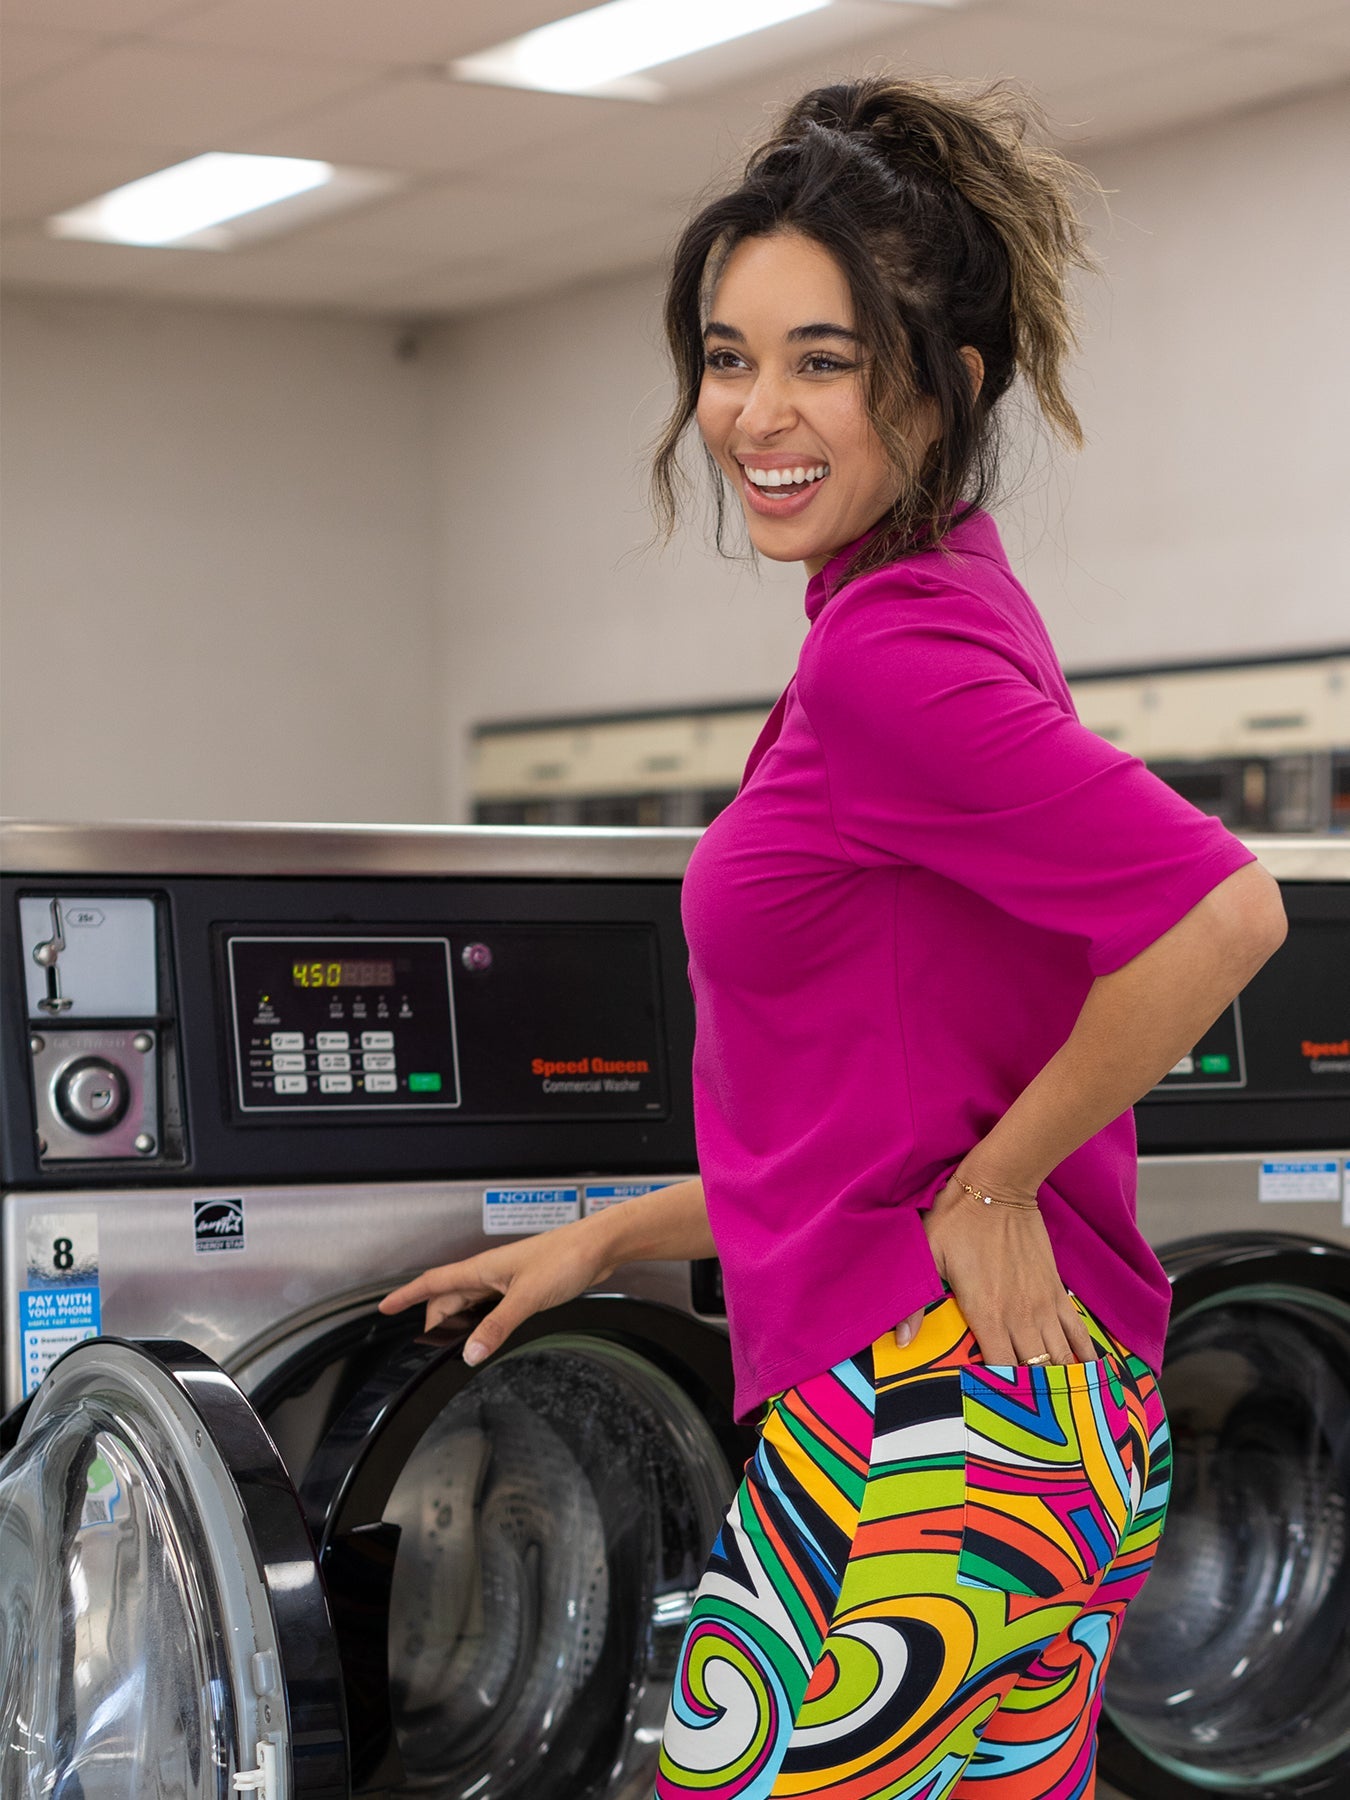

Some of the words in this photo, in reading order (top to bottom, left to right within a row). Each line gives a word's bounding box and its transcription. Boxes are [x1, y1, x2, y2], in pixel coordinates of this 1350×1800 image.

[531, 1058, 589, 1078] Speed
[591, 1057, 649, 1073] Queen
[542, 1079, 602, 1093] Commercial
[603, 1079, 641, 1092] Washer
[498, 1190, 565, 1203] NOTICE
[53, 1237, 74, 1270] 8
[28, 1295, 54, 1309] PAY
[55, 1292, 92, 1306] WITH
[28, 1307, 57, 1319] YOUR
[58, 1305, 93, 1317] PHONE
